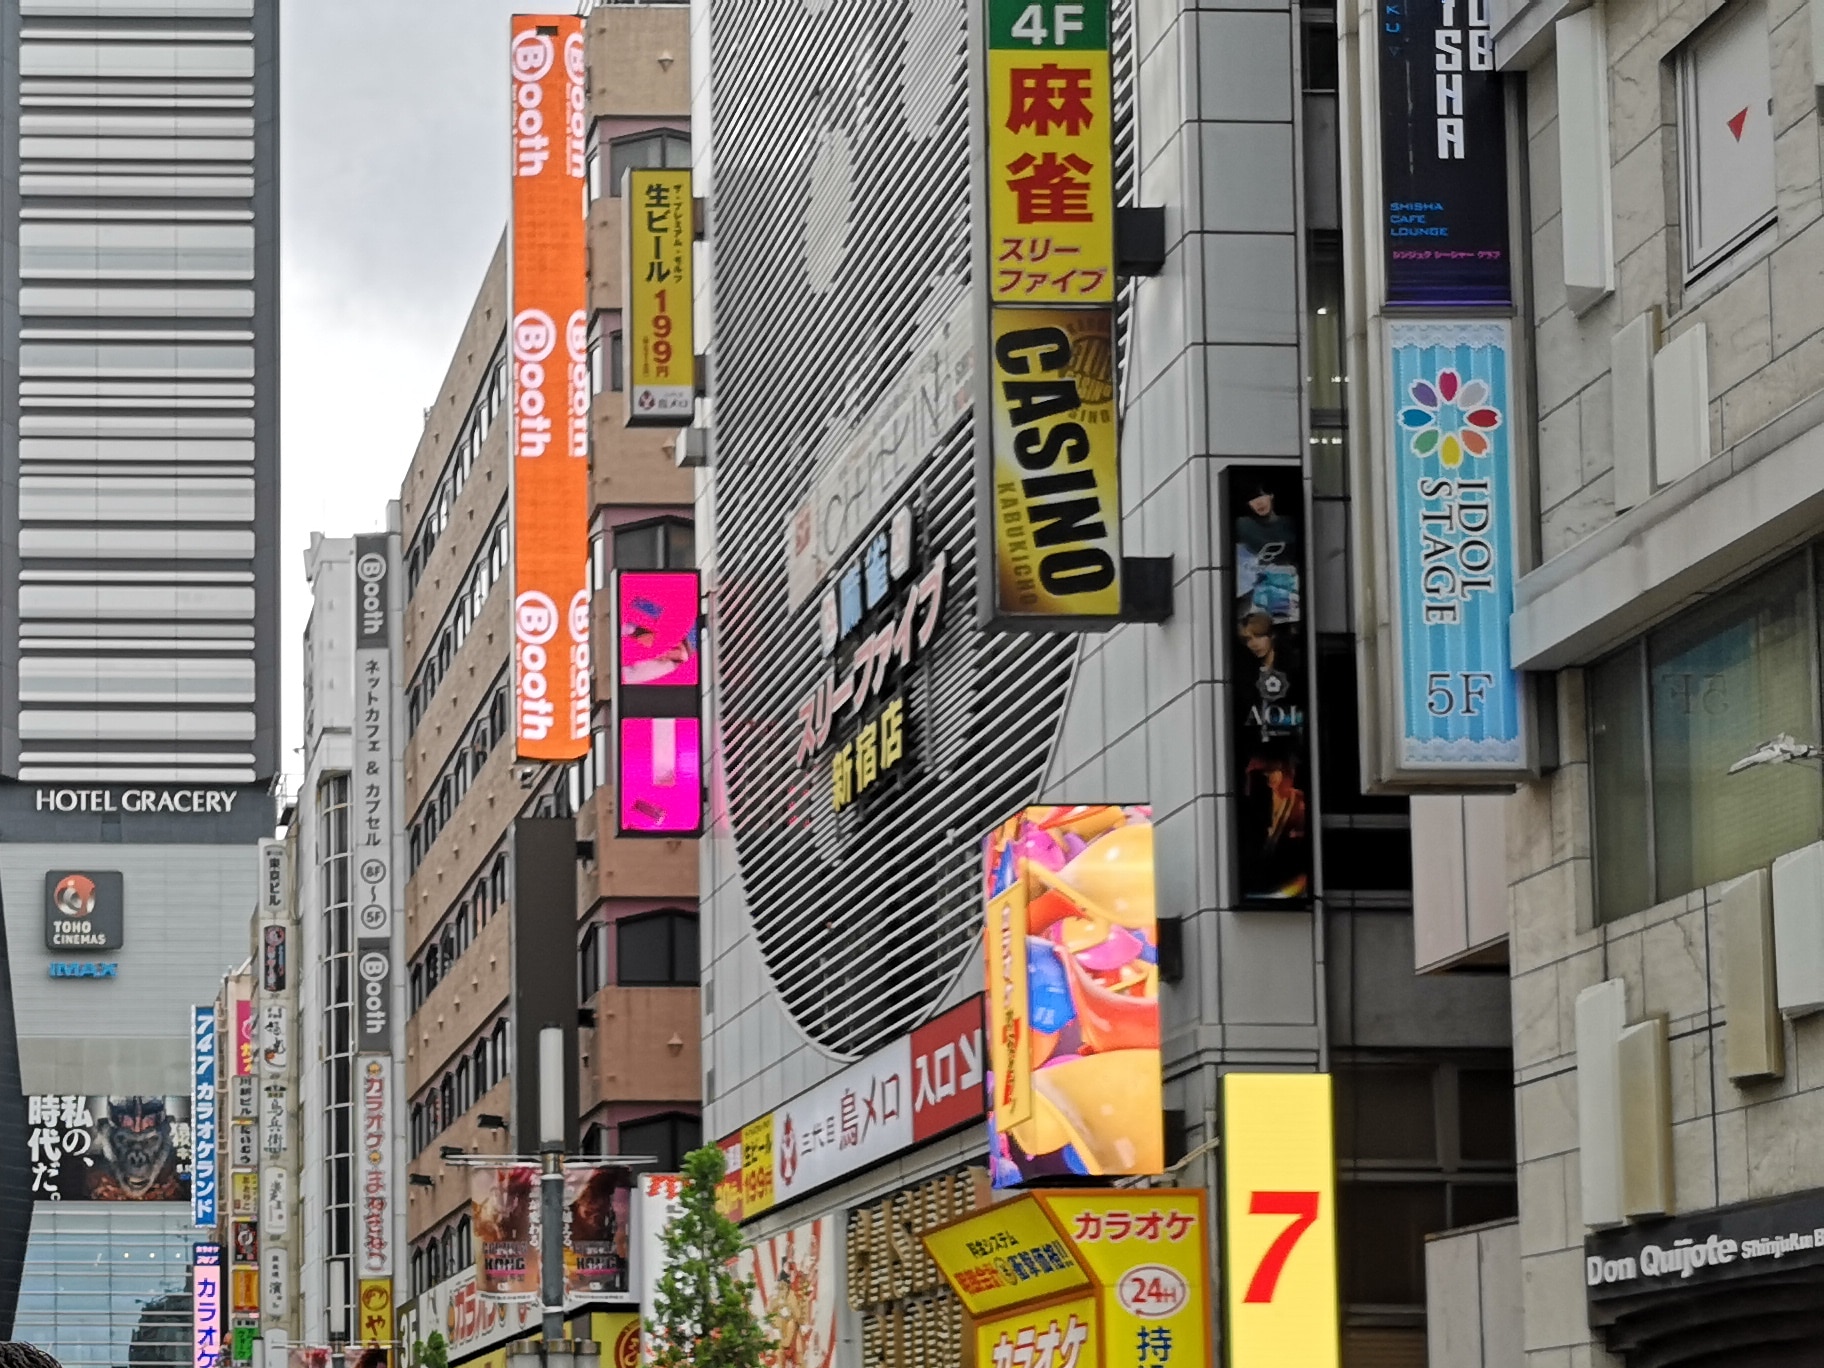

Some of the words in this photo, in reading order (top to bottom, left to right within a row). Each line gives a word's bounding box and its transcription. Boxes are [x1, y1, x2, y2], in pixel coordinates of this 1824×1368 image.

[1011, 5, 1084, 45] 4F
[1005, 63, 1093, 224] 麻雀
[644, 183, 671, 283] 生ビール
[1390, 202, 1444, 212] SHISHA
[1390, 215, 1426, 224] CAFE
[1390, 227, 1449, 237] LOUNGE
[998, 268, 1108, 294] ファイブ
[999, 237, 1081, 263] スリー
[651, 289, 673, 379] 199円
[514, 309, 557, 459] Booth
[995, 326, 1116, 597] CASINO
[997, 481, 1038, 605] KABUKICHO
[1419, 475, 1458, 627] STAGE
[1456, 475, 1494, 606] IDOL
[357, 551, 387, 634] Booth
[515, 590, 559, 742] Booth
[1426, 672, 1494, 718] 5F
[832, 697, 904, 812] 新宿店
[36, 789, 117, 812] HOTEL
[121, 789, 238, 813] GRACERY
[53, 920, 92, 934] TOHO
[53, 933, 107, 945] CINEMAS
[49, 961, 119, 978] IMAX
[359, 952, 389, 1034] Booth
[27, 1095, 62, 1201] 時代だ。
[60, 1095, 95, 1168] 私の、
[196, 1082, 215, 1219] カラオケランド
[1074, 1210, 1197, 1243] カラオケ
[1242, 1190, 1321, 1304] 7
[484, 1255, 526, 1271] KONG
[575, 1255, 618, 1270] KONG
[1130, 1277, 1178, 1305] 24H
[1586, 1252, 1637, 1287] Don
[1639, 1234, 1738, 1279] Quijote
